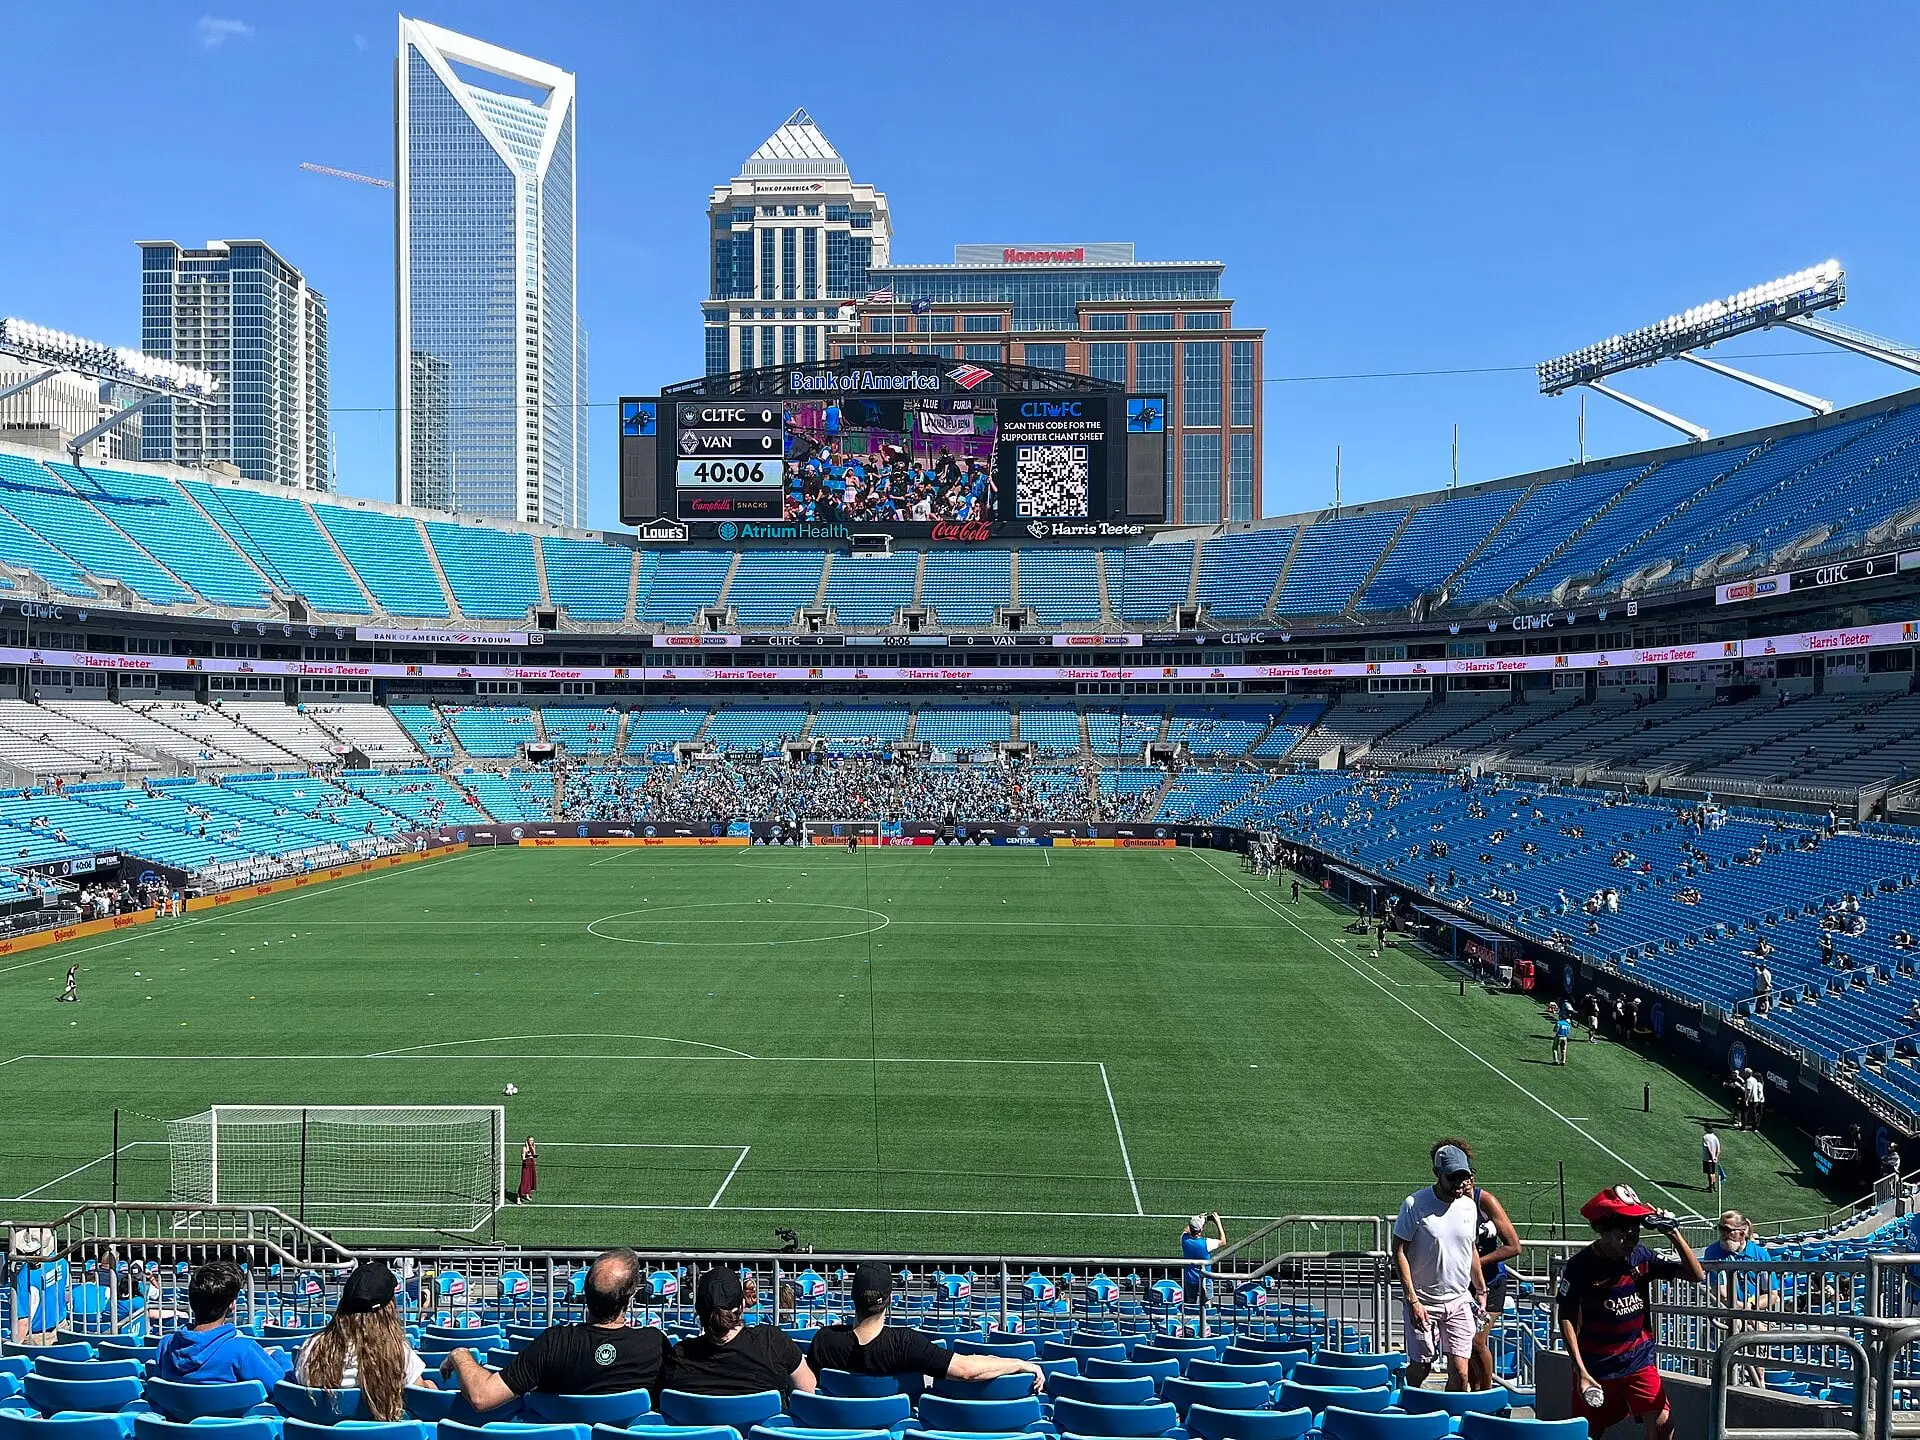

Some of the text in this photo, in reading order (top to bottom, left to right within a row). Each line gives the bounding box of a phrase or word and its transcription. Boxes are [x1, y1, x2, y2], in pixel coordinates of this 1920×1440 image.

[1003, 247, 1084, 263] Honeywell
[791, 371, 940, 390] Bank of America
[701, 409, 772, 422] CLTFC 0
[1004, 422, 1026, 430] SCAN
[1026, 422, 1044, 430] THIS
[1046, 422, 1068, 430] CODE
[1068, 422, 1085, 430] FOR
[701, 436, 772, 449] VAN 0
[1002, 434, 1047, 442] SUPPORTER
[1048, 433, 1078, 441] CHANT
[694, 463, 765, 483] 40:06
[741, 524, 848, 538] Atrium Health
[1052, 523, 1144, 536] Harris Teeter
[1816, 561, 1873, 585] CLTFC 0
[412, 634, 451, 642] AMERICA
[472, 636, 511, 644] STADIUM
[531, 634, 543, 643] CC
[768, 636, 823, 645] CLTFC 0
[883, 636, 911, 646] 40:06
[967, 636, 1016, 645] 0 VAN
[1809, 633, 1870, 649] Harris Teeter
[1642, 650, 1696, 662] Harris Teeter
[85, 656, 151, 669] Harris Teeter
[1465, 661, 1527, 671] Harris Teeter
[299, 664, 370, 675] Harris Teeter
[514, 669, 580, 678] Harris Teeter
[714, 670, 776, 678] Harris Teeter
[909, 670, 972, 678] Harris Teeter
[1068, 670, 1133, 678] Harris Teeter
[1268, 667, 1332, 676] Harris Teeter
[1072, 838, 1096, 846] Bojangles
[97, 856, 118, 865] CENTENE
[49, 866, 55, 874] 0
[76, 862, 92, 871] 40:06
[54, 928, 76, 941] Bojangles
